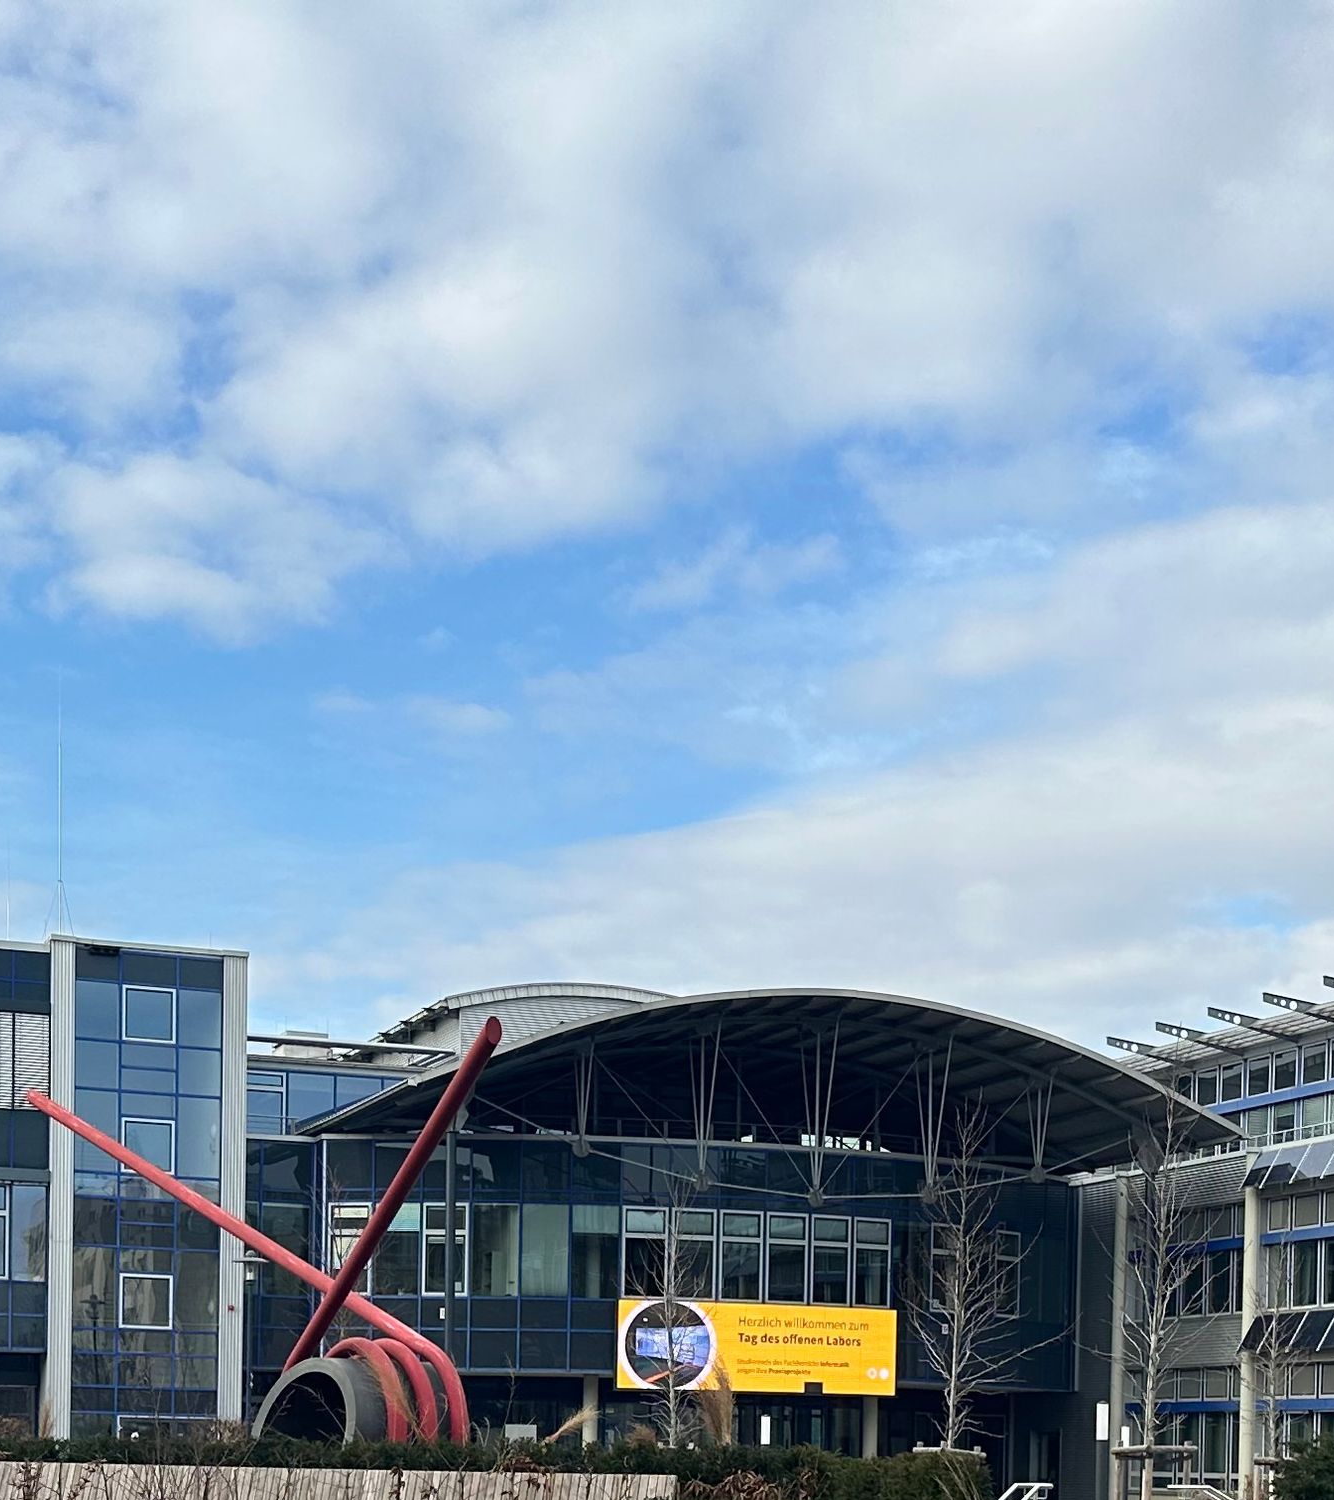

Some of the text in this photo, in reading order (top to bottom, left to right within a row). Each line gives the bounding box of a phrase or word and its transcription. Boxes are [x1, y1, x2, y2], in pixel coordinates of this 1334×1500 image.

[739, 1316, 869, 1331] Herzlich willkommen zum
[738, 1332, 862, 1347] Tag des offenen Labors
